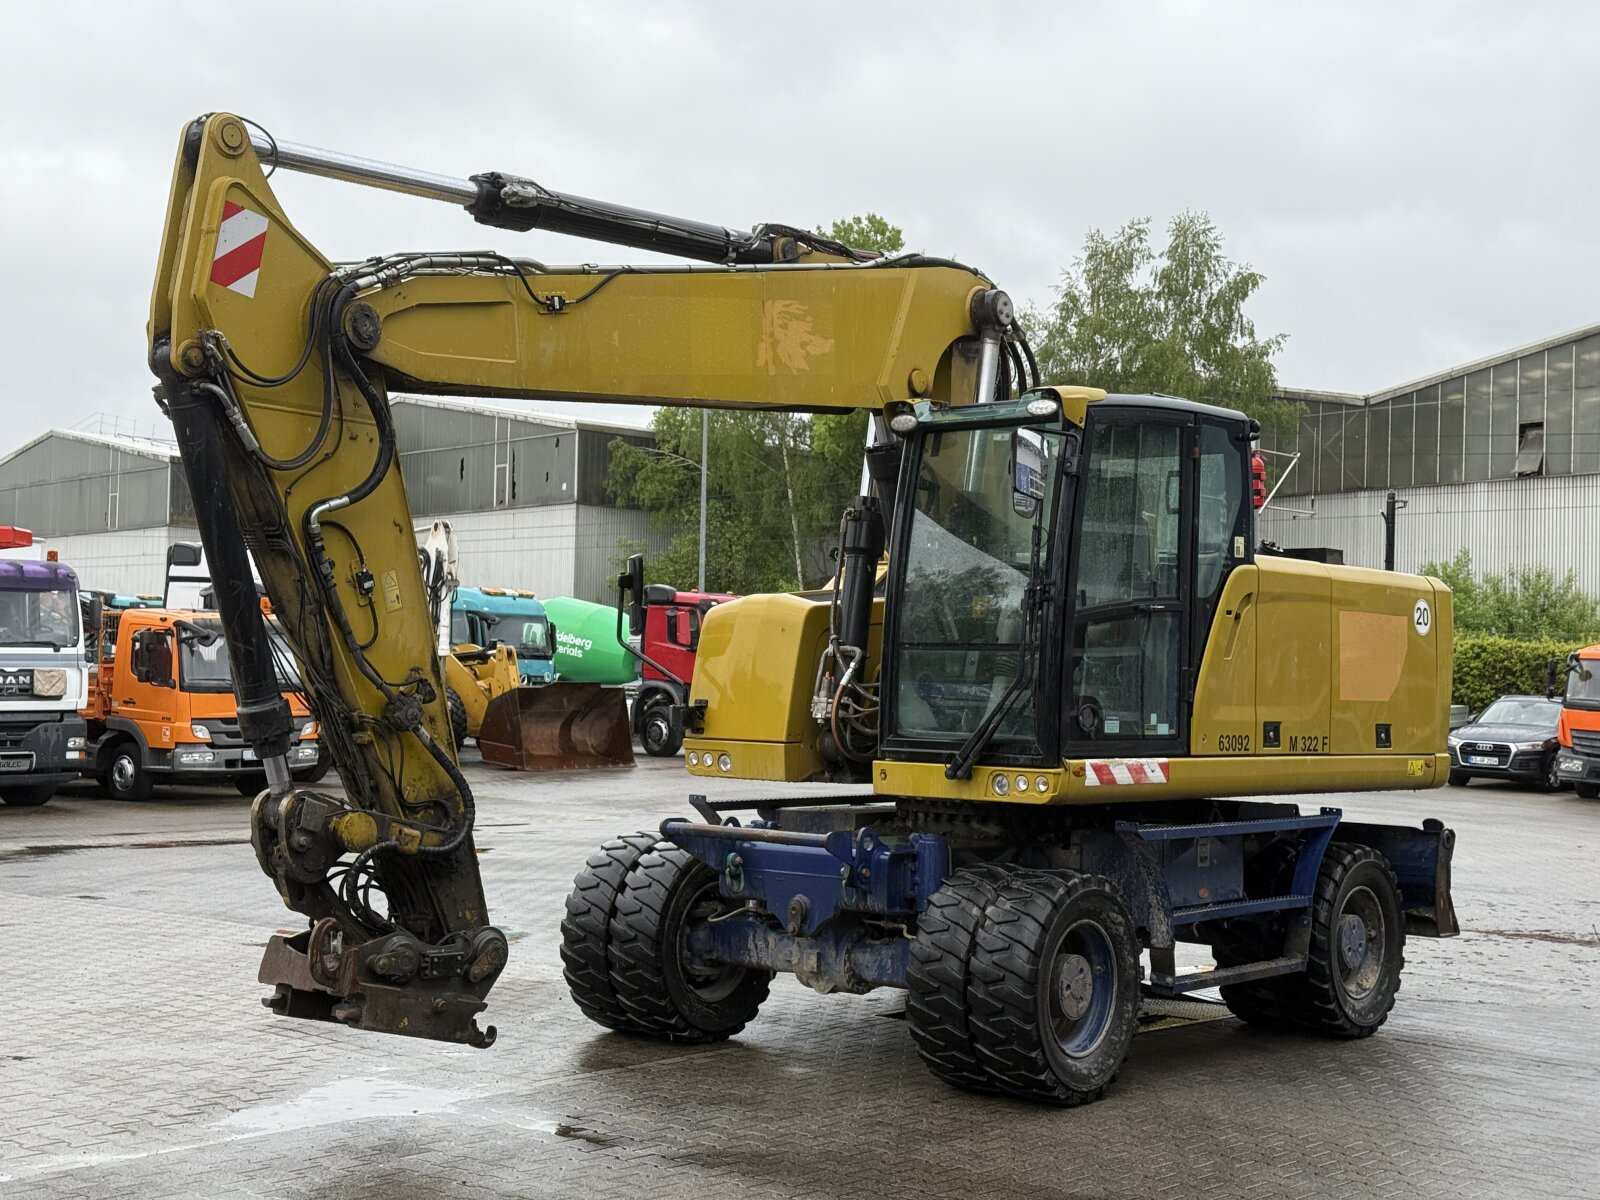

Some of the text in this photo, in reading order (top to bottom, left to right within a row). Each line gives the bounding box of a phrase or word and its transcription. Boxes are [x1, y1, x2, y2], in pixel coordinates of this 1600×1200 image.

[1416, 607, 1429, 626] 20
[556, 644, 583, 657] erials
[0, 675, 31, 684] AN
[1218, 734, 1250, 752] 63092
[1289, 736, 1328, 752] M 322 F
